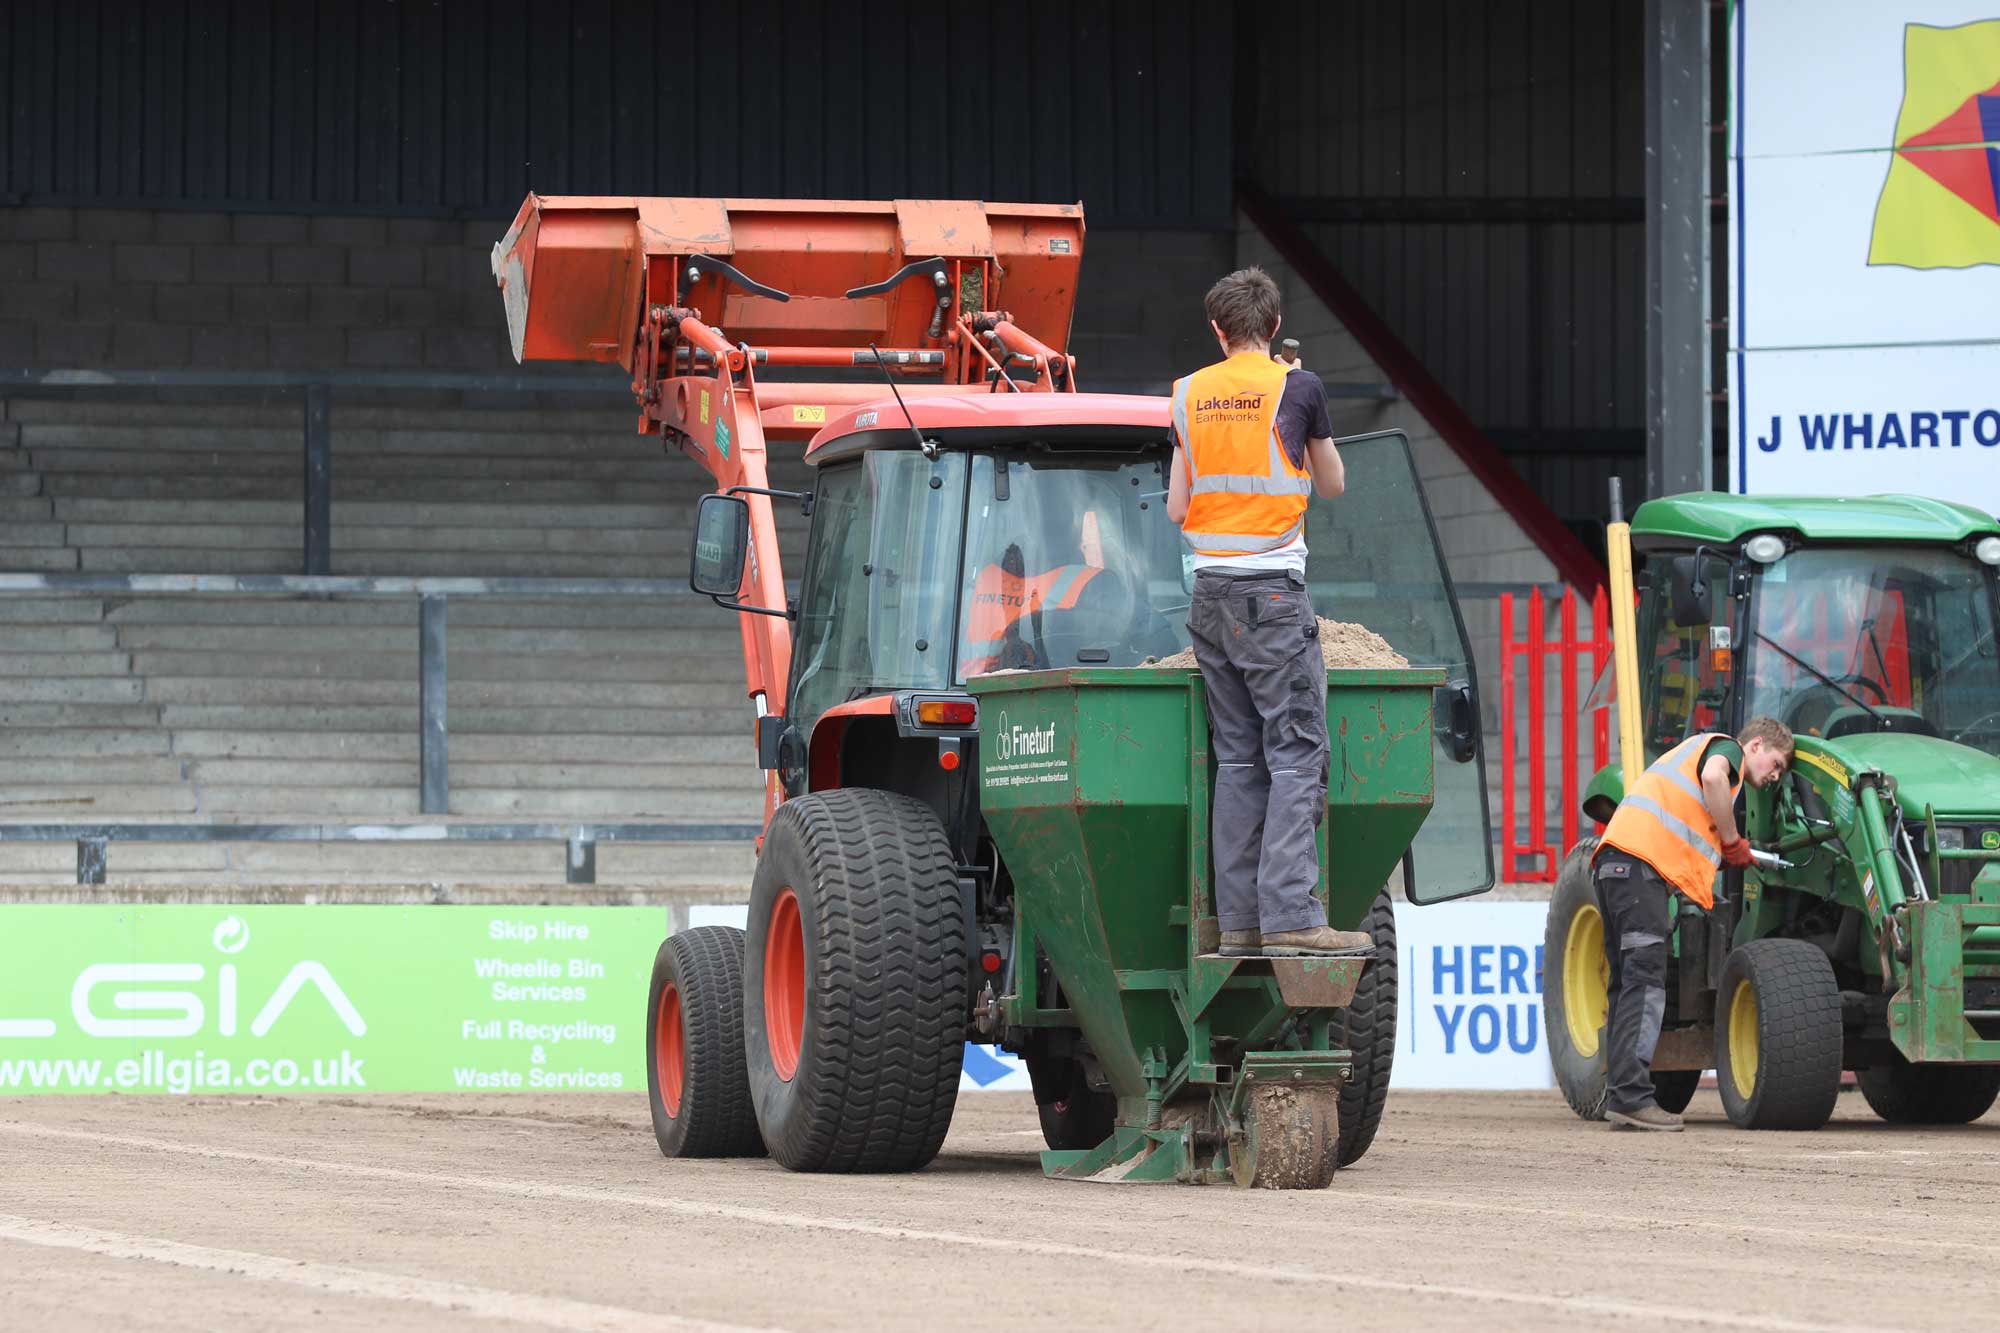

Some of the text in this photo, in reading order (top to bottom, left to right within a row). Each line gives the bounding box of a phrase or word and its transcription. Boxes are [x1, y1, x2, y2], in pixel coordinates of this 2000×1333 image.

[1196, 396, 1261, 412] Lakeland
[1196, 411, 1260, 424] Earthworks
[1758, 416, 1781, 452] J
[1013, 721, 1055, 756] Fineturf
[489, 920, 589, 943] Skip Hire
[474, 959, 604, 978] Wheelie Bin
[492, 981, 586, 1001] Services
[462, 1019, 616, 1043] Full Recycling
[1433, 1004, 1538, 1054] YOU
[530, 1044, 547, 1064] &
[453, 1067, 623, 1088] Waste Services
